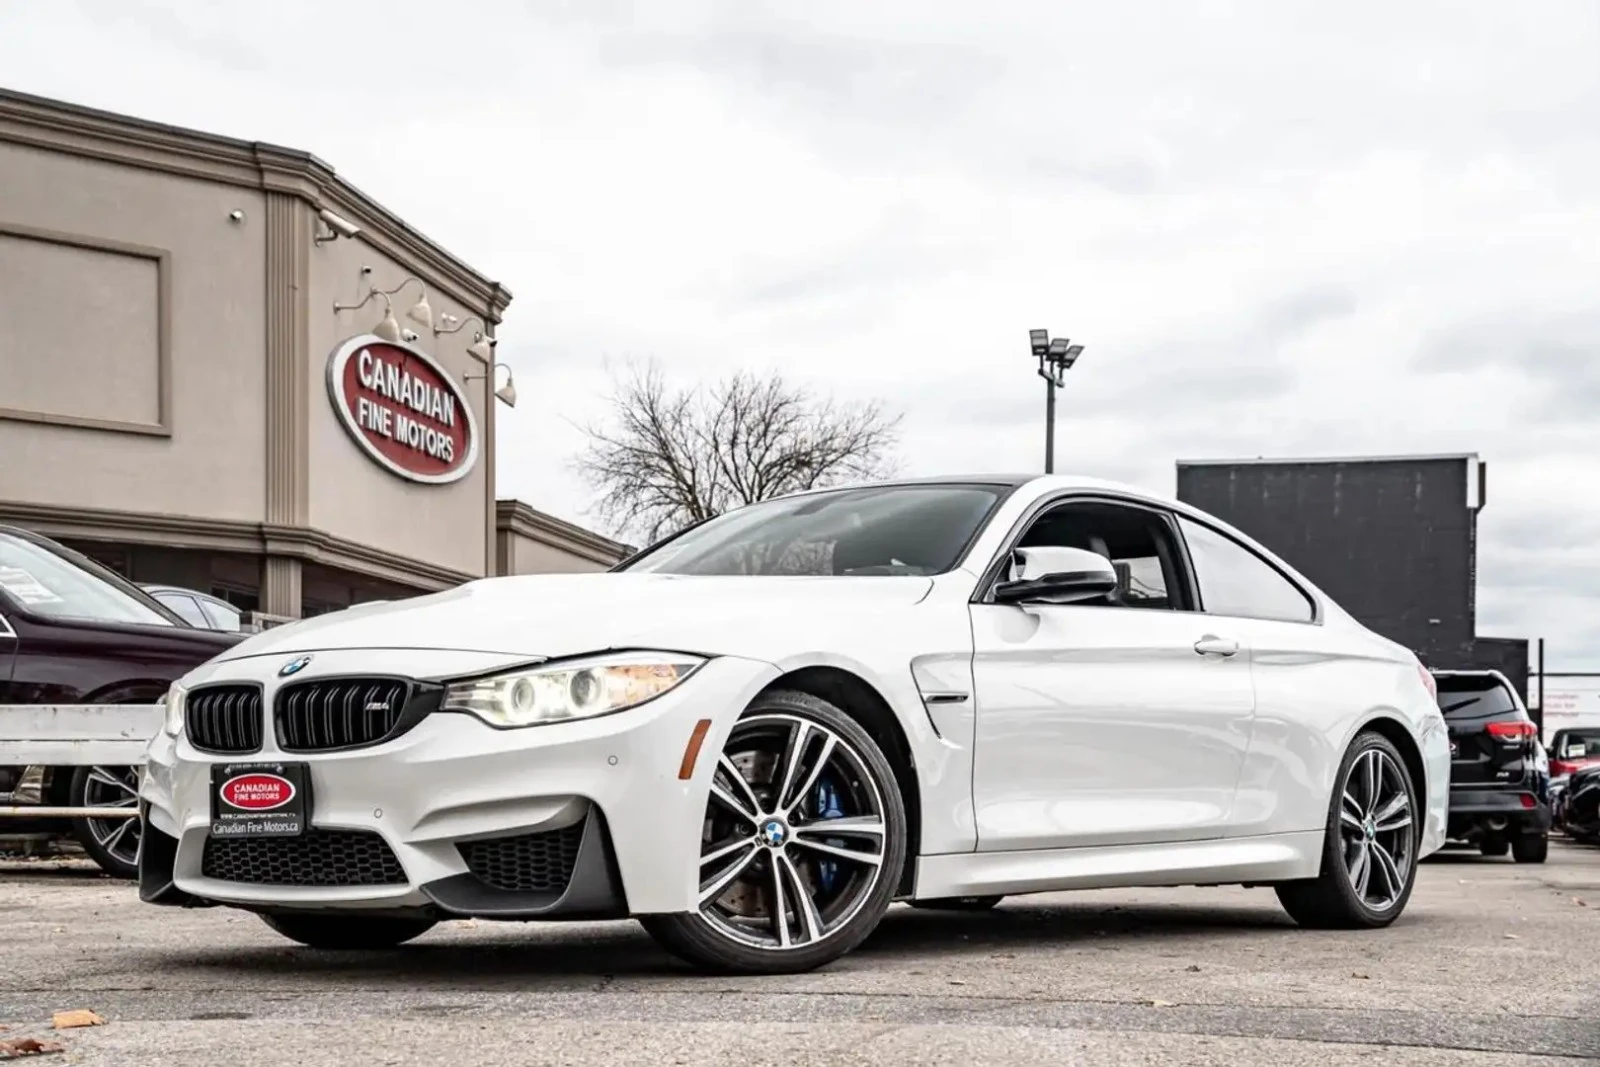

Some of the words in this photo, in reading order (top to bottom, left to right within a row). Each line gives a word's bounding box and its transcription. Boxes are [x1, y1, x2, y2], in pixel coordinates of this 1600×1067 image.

[358, 349, 455, 427] CANADIAN
[358, 397, 392, 437] FINE
[396, 414, 454, 463] MOTORS
[234, 783, 280, 792] CANADIAN
[251, 792, 280, 800] MOTORS
[213, 823, 246, 834] Canadian
[247, 822, 263, 833] Fine
[264, 821, 298, 832] Motors.ca
